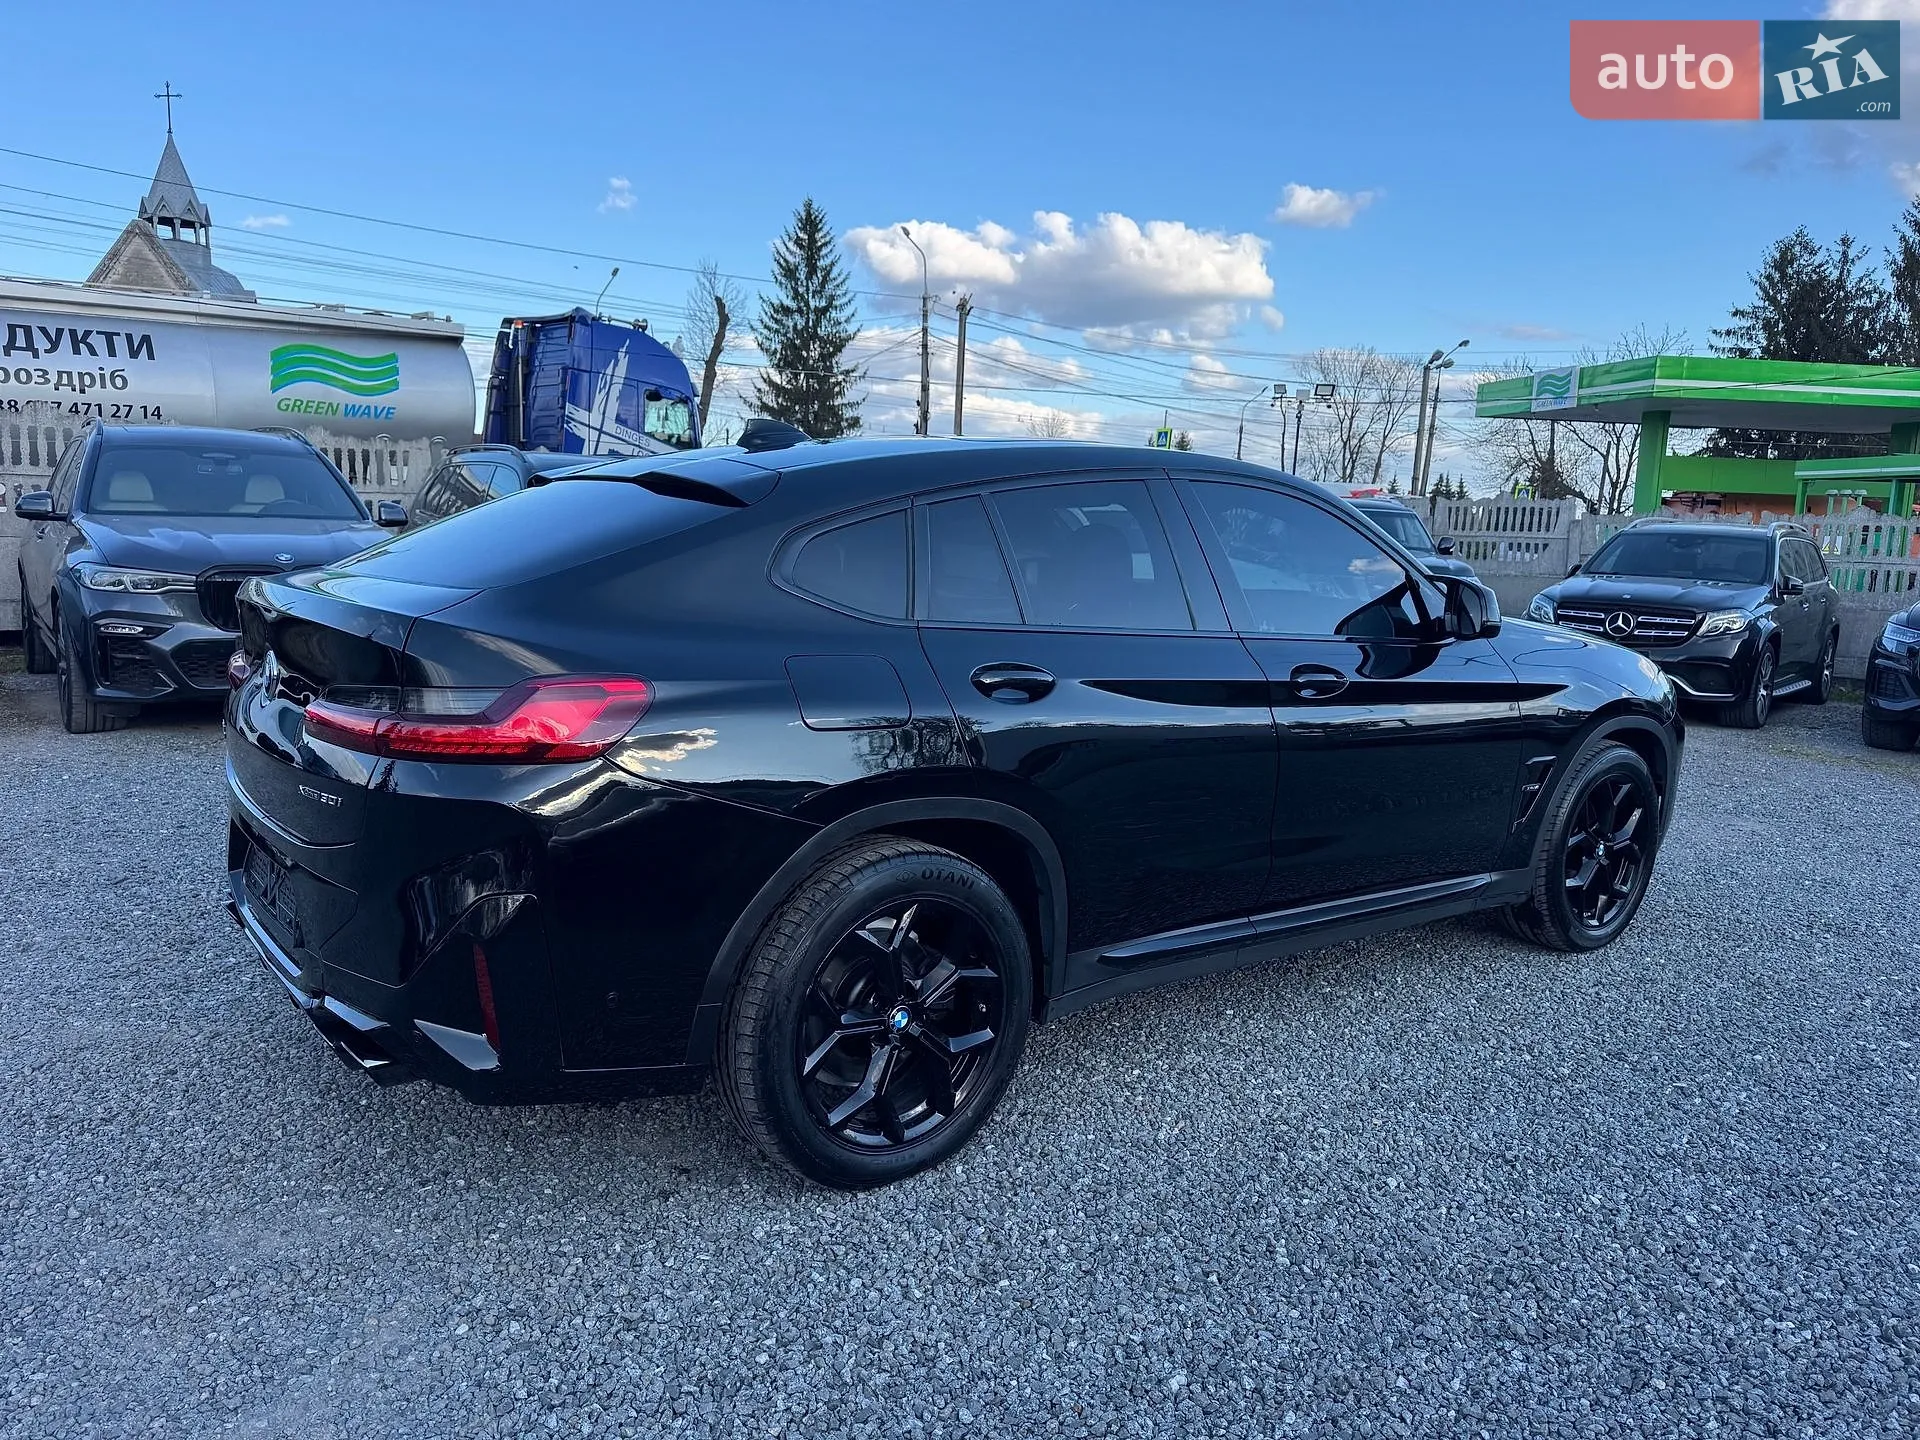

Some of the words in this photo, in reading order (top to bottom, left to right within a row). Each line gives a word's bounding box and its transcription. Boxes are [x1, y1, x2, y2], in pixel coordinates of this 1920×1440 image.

[2, 323, 156, 361] ДУКТИ
[110, 403, 134, 418] 27
[140, 405, 163, 420] 14
[276, 397, 341, 416] GREEN
[343, 403, 397, 420] WAVE
[614, 425, 651, 447] DINGES
[921, 867, 975, 889] OTANI
